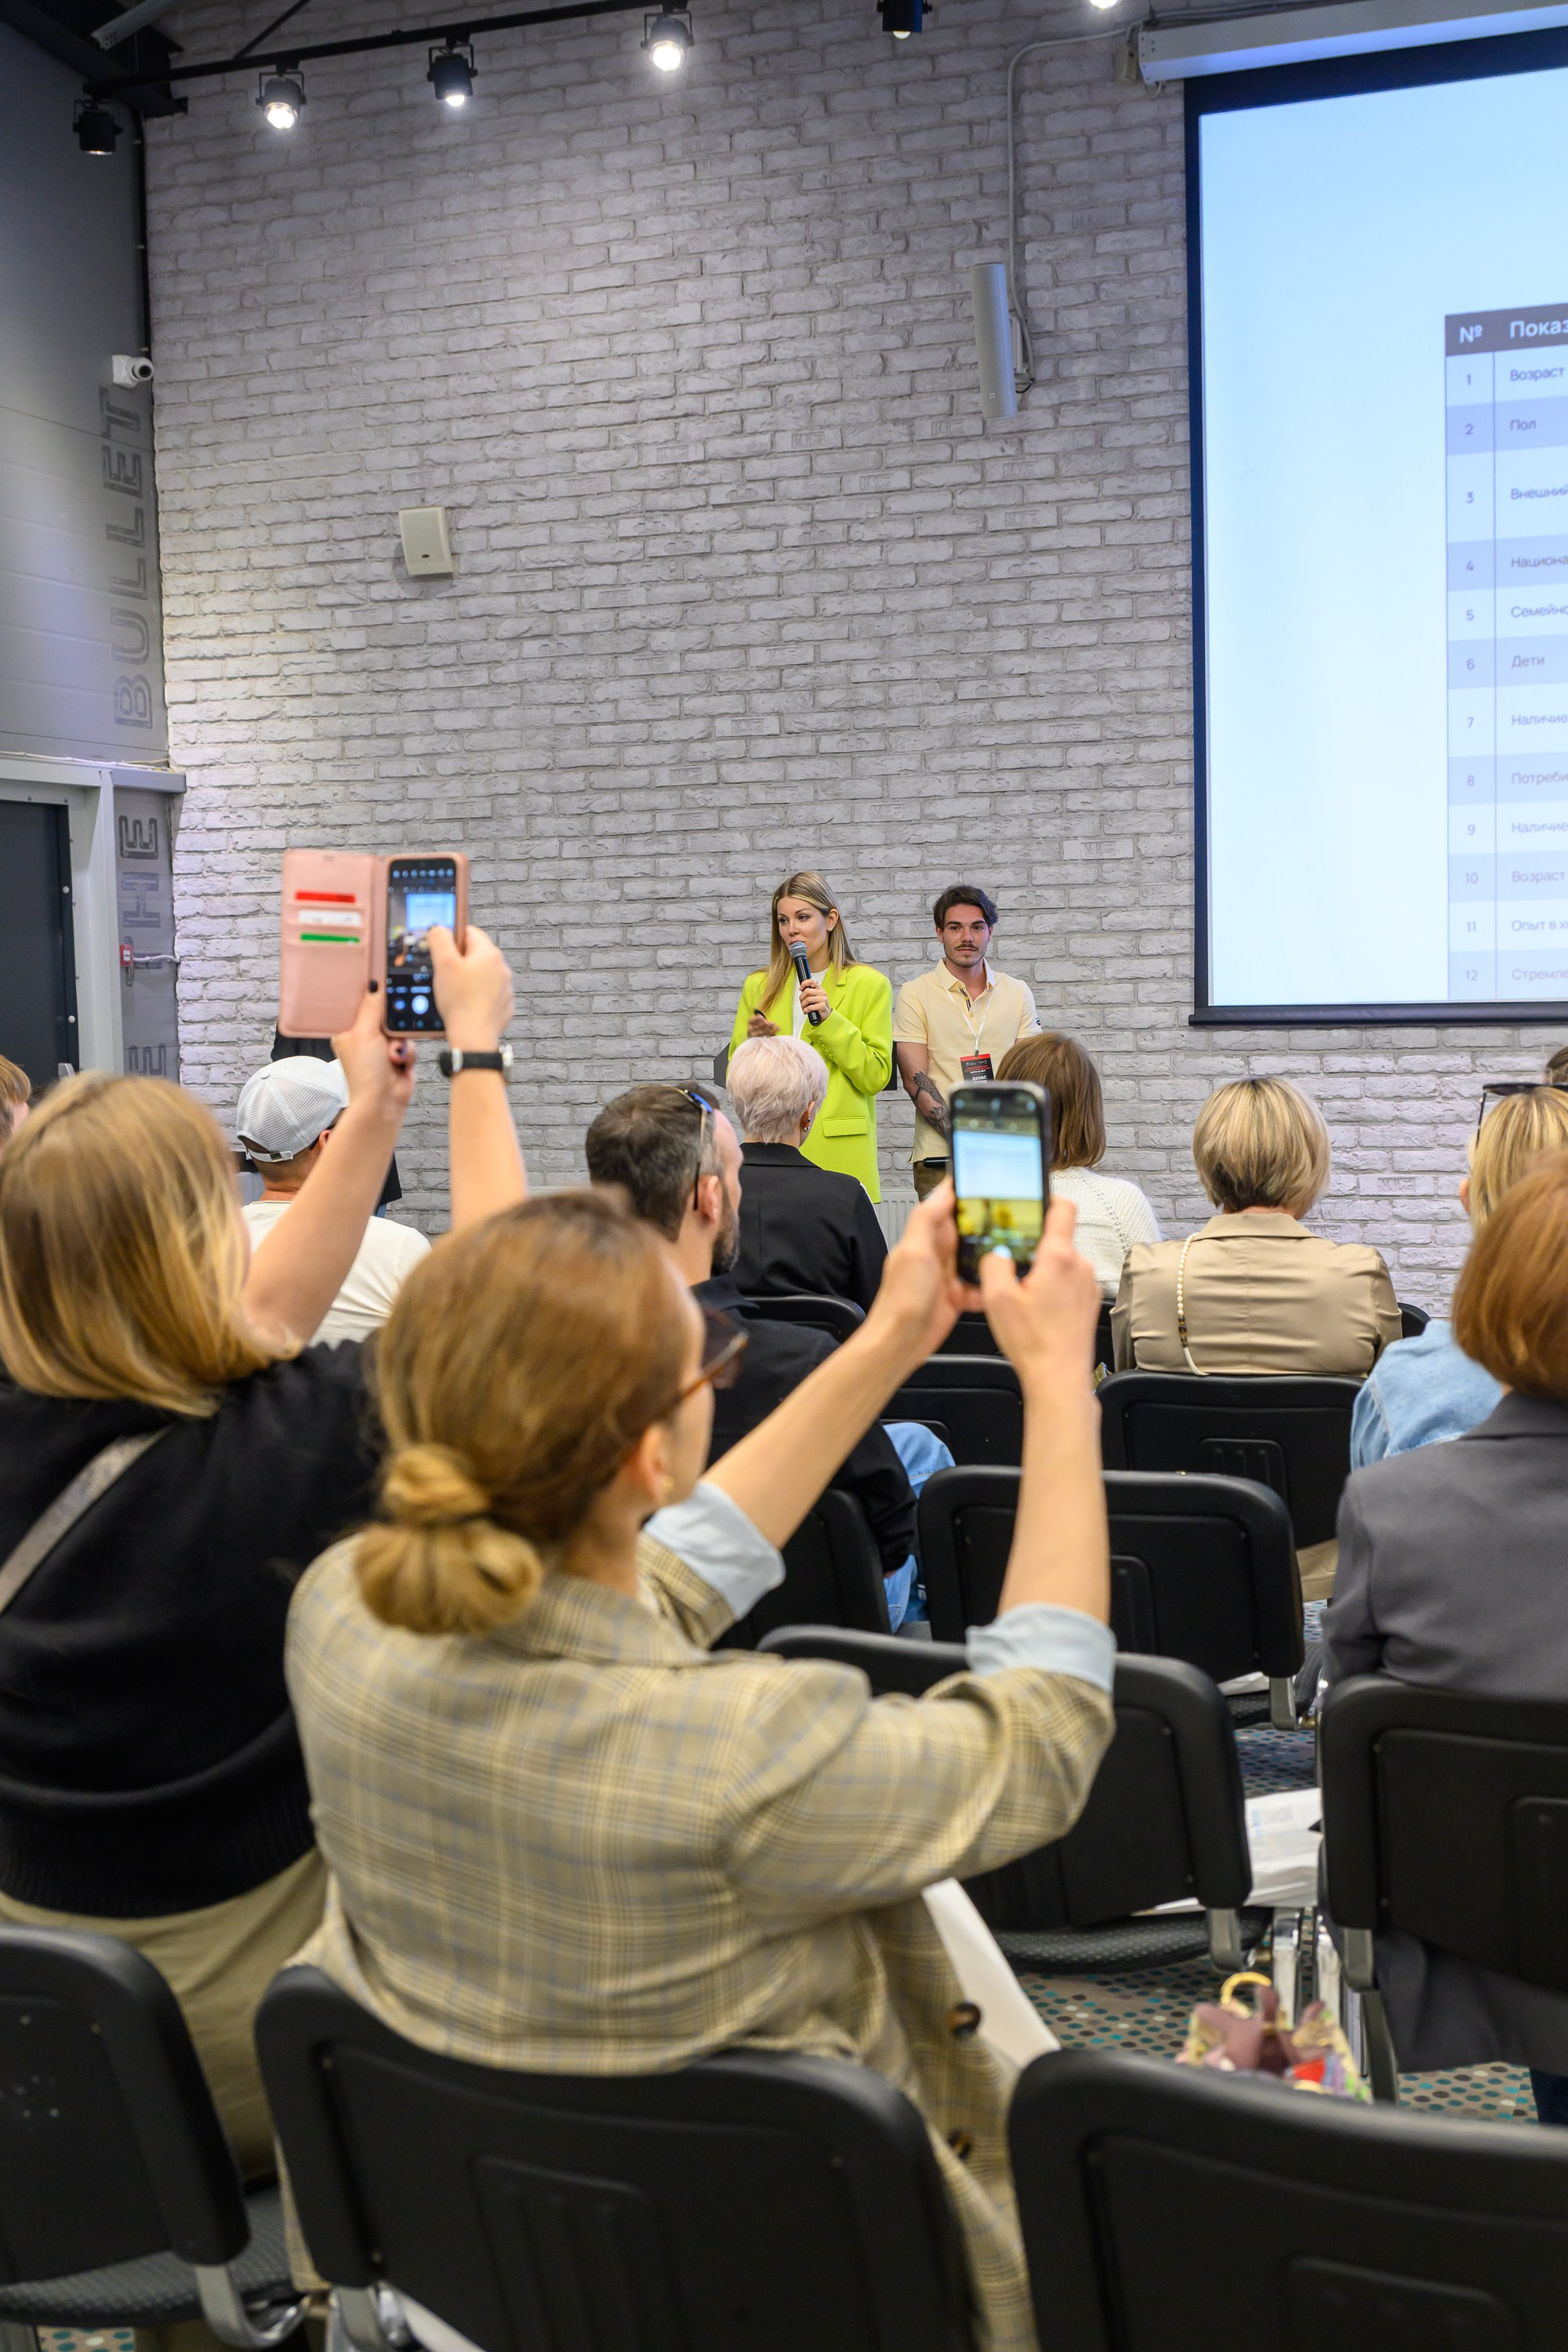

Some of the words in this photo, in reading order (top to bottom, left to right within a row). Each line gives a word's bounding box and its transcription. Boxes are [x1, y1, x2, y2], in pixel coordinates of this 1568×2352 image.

[1459, 324, 1483, 343] №
[1466, 374, 1472, 385] 1
[1510, 367, 1565, 383] Возраст
[1465, 423, 1474, 435] 2
[1510, 419, 1537, 431] Пол
[1466, 492, 1474, 503] 3
[99, 386, 154, 729] BULLET
[1466, 560, 1474, 572] 4
[1466, 609, 1475, 621] 5
[1466, 658, 1475, 670] 6
[1511, 655, 1545, 668] Дети
[1467, 717, 1475, 728] 7
[1512, 713, 1568, 726] Наличие
[1467, 775, 1475, 786] 8
[1467, 823, 1475, 836] 9
[1512, 821, 1568, 833] Наличие
[1465, 872, 1479, 884] 10
[1512, 870, 1566, 884] Возраст
[1466, 921, 1476, 932] 11
[1511, 919, 1546, 931] Опыт
[1465, 969, 1479, 982] 12
